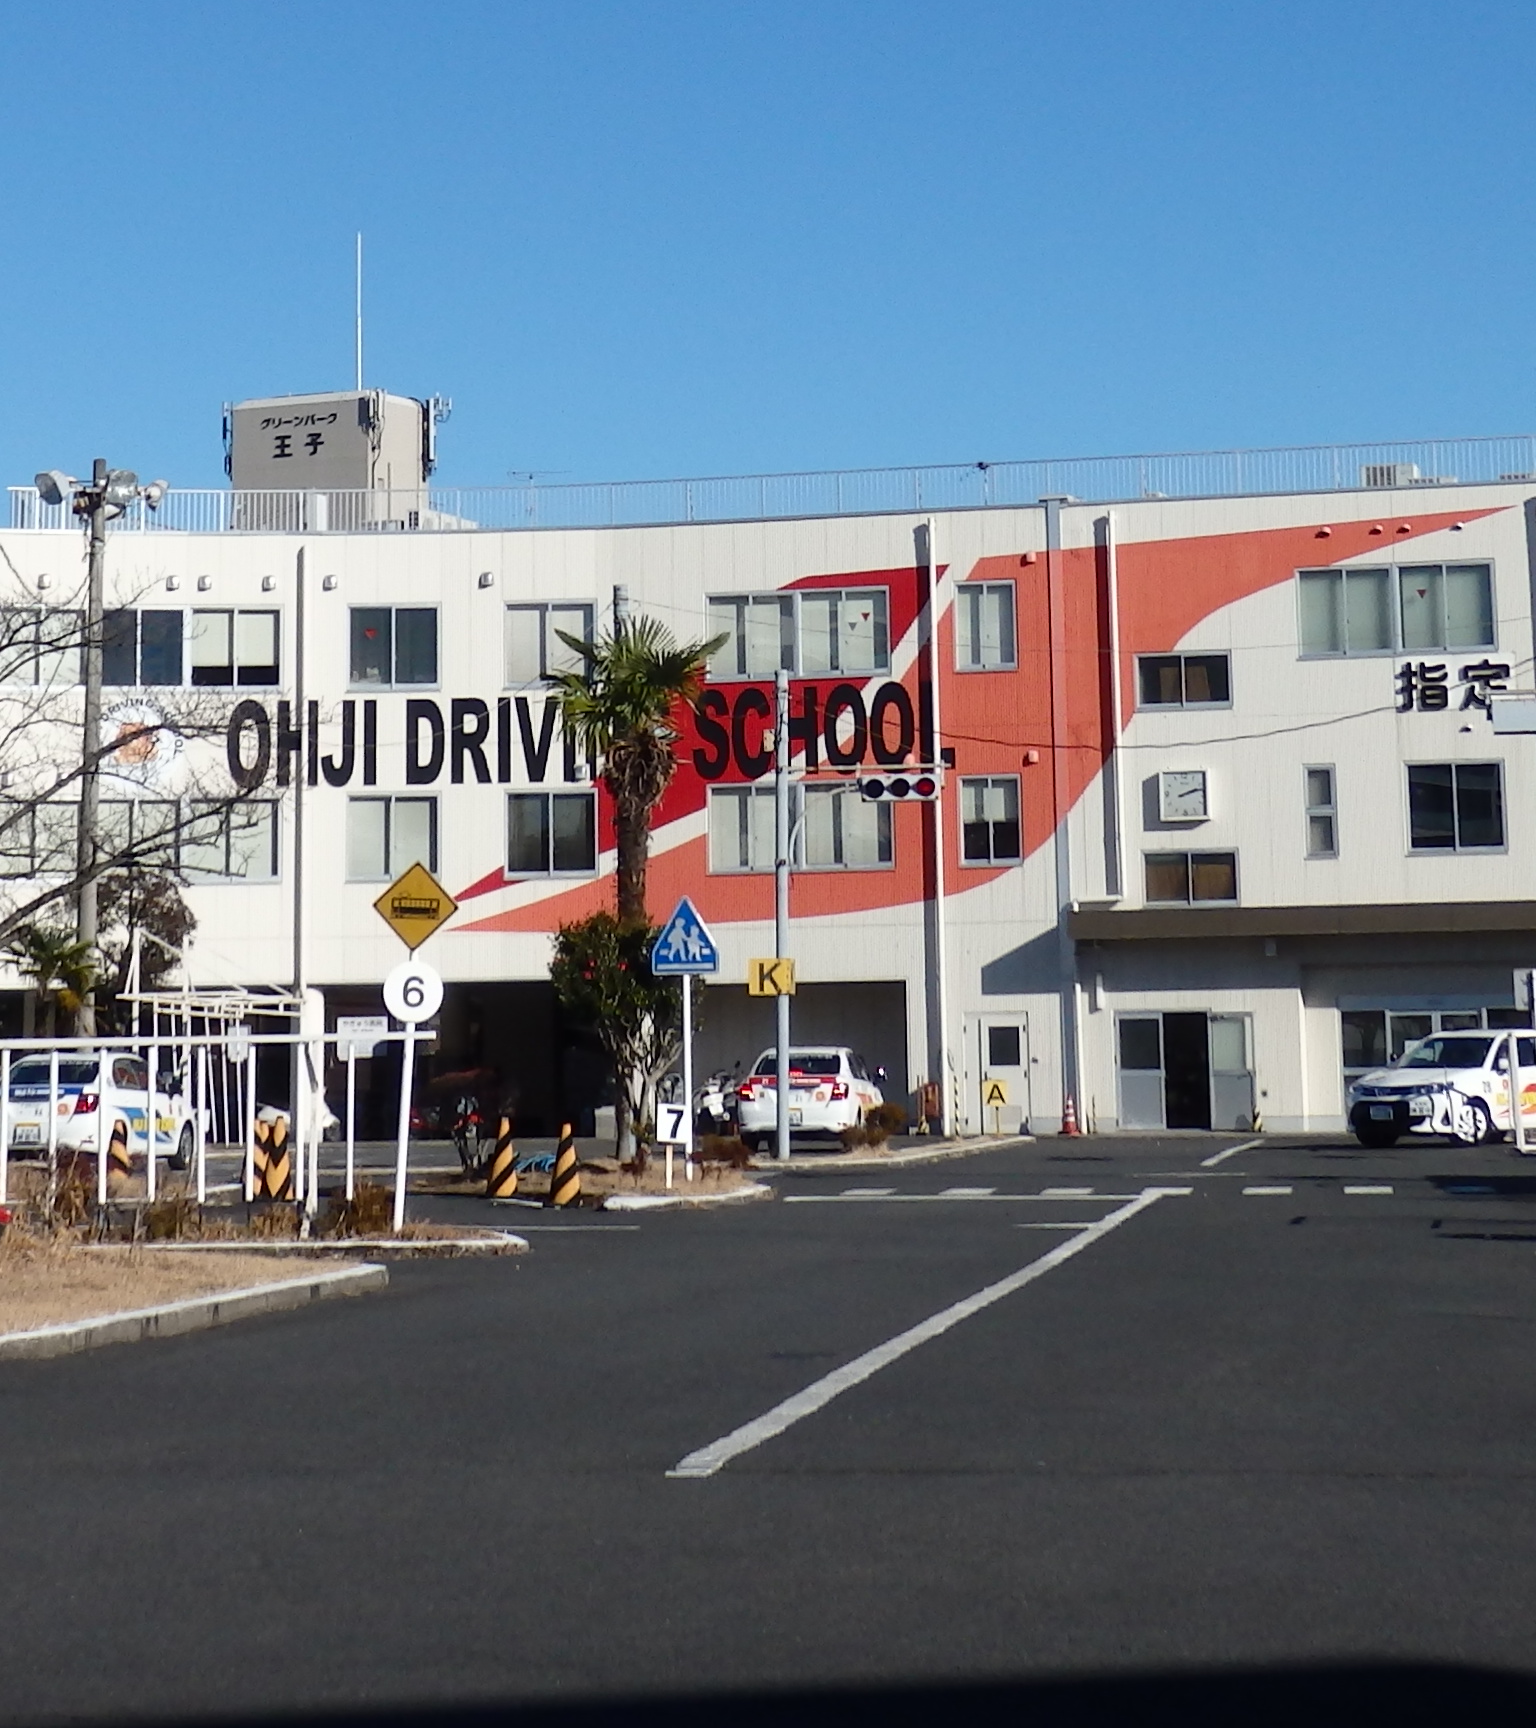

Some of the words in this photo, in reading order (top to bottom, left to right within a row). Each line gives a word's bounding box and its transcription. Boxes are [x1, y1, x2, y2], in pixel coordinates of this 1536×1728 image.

[272, 432, 325, 459] 王子
[1395, 659, 1511, 721] 指定
[227, 699, 377, 788] OHJI
[406, 696, 598, 785] DRIVI
[693, 680, 955, 781] SCHOOL
[403, 976, 424, 1008] 6
[759, 962, 782, 994] K
[986, 1084, 1006, 1104] A
[667, 1108, 684, 1139] 7
